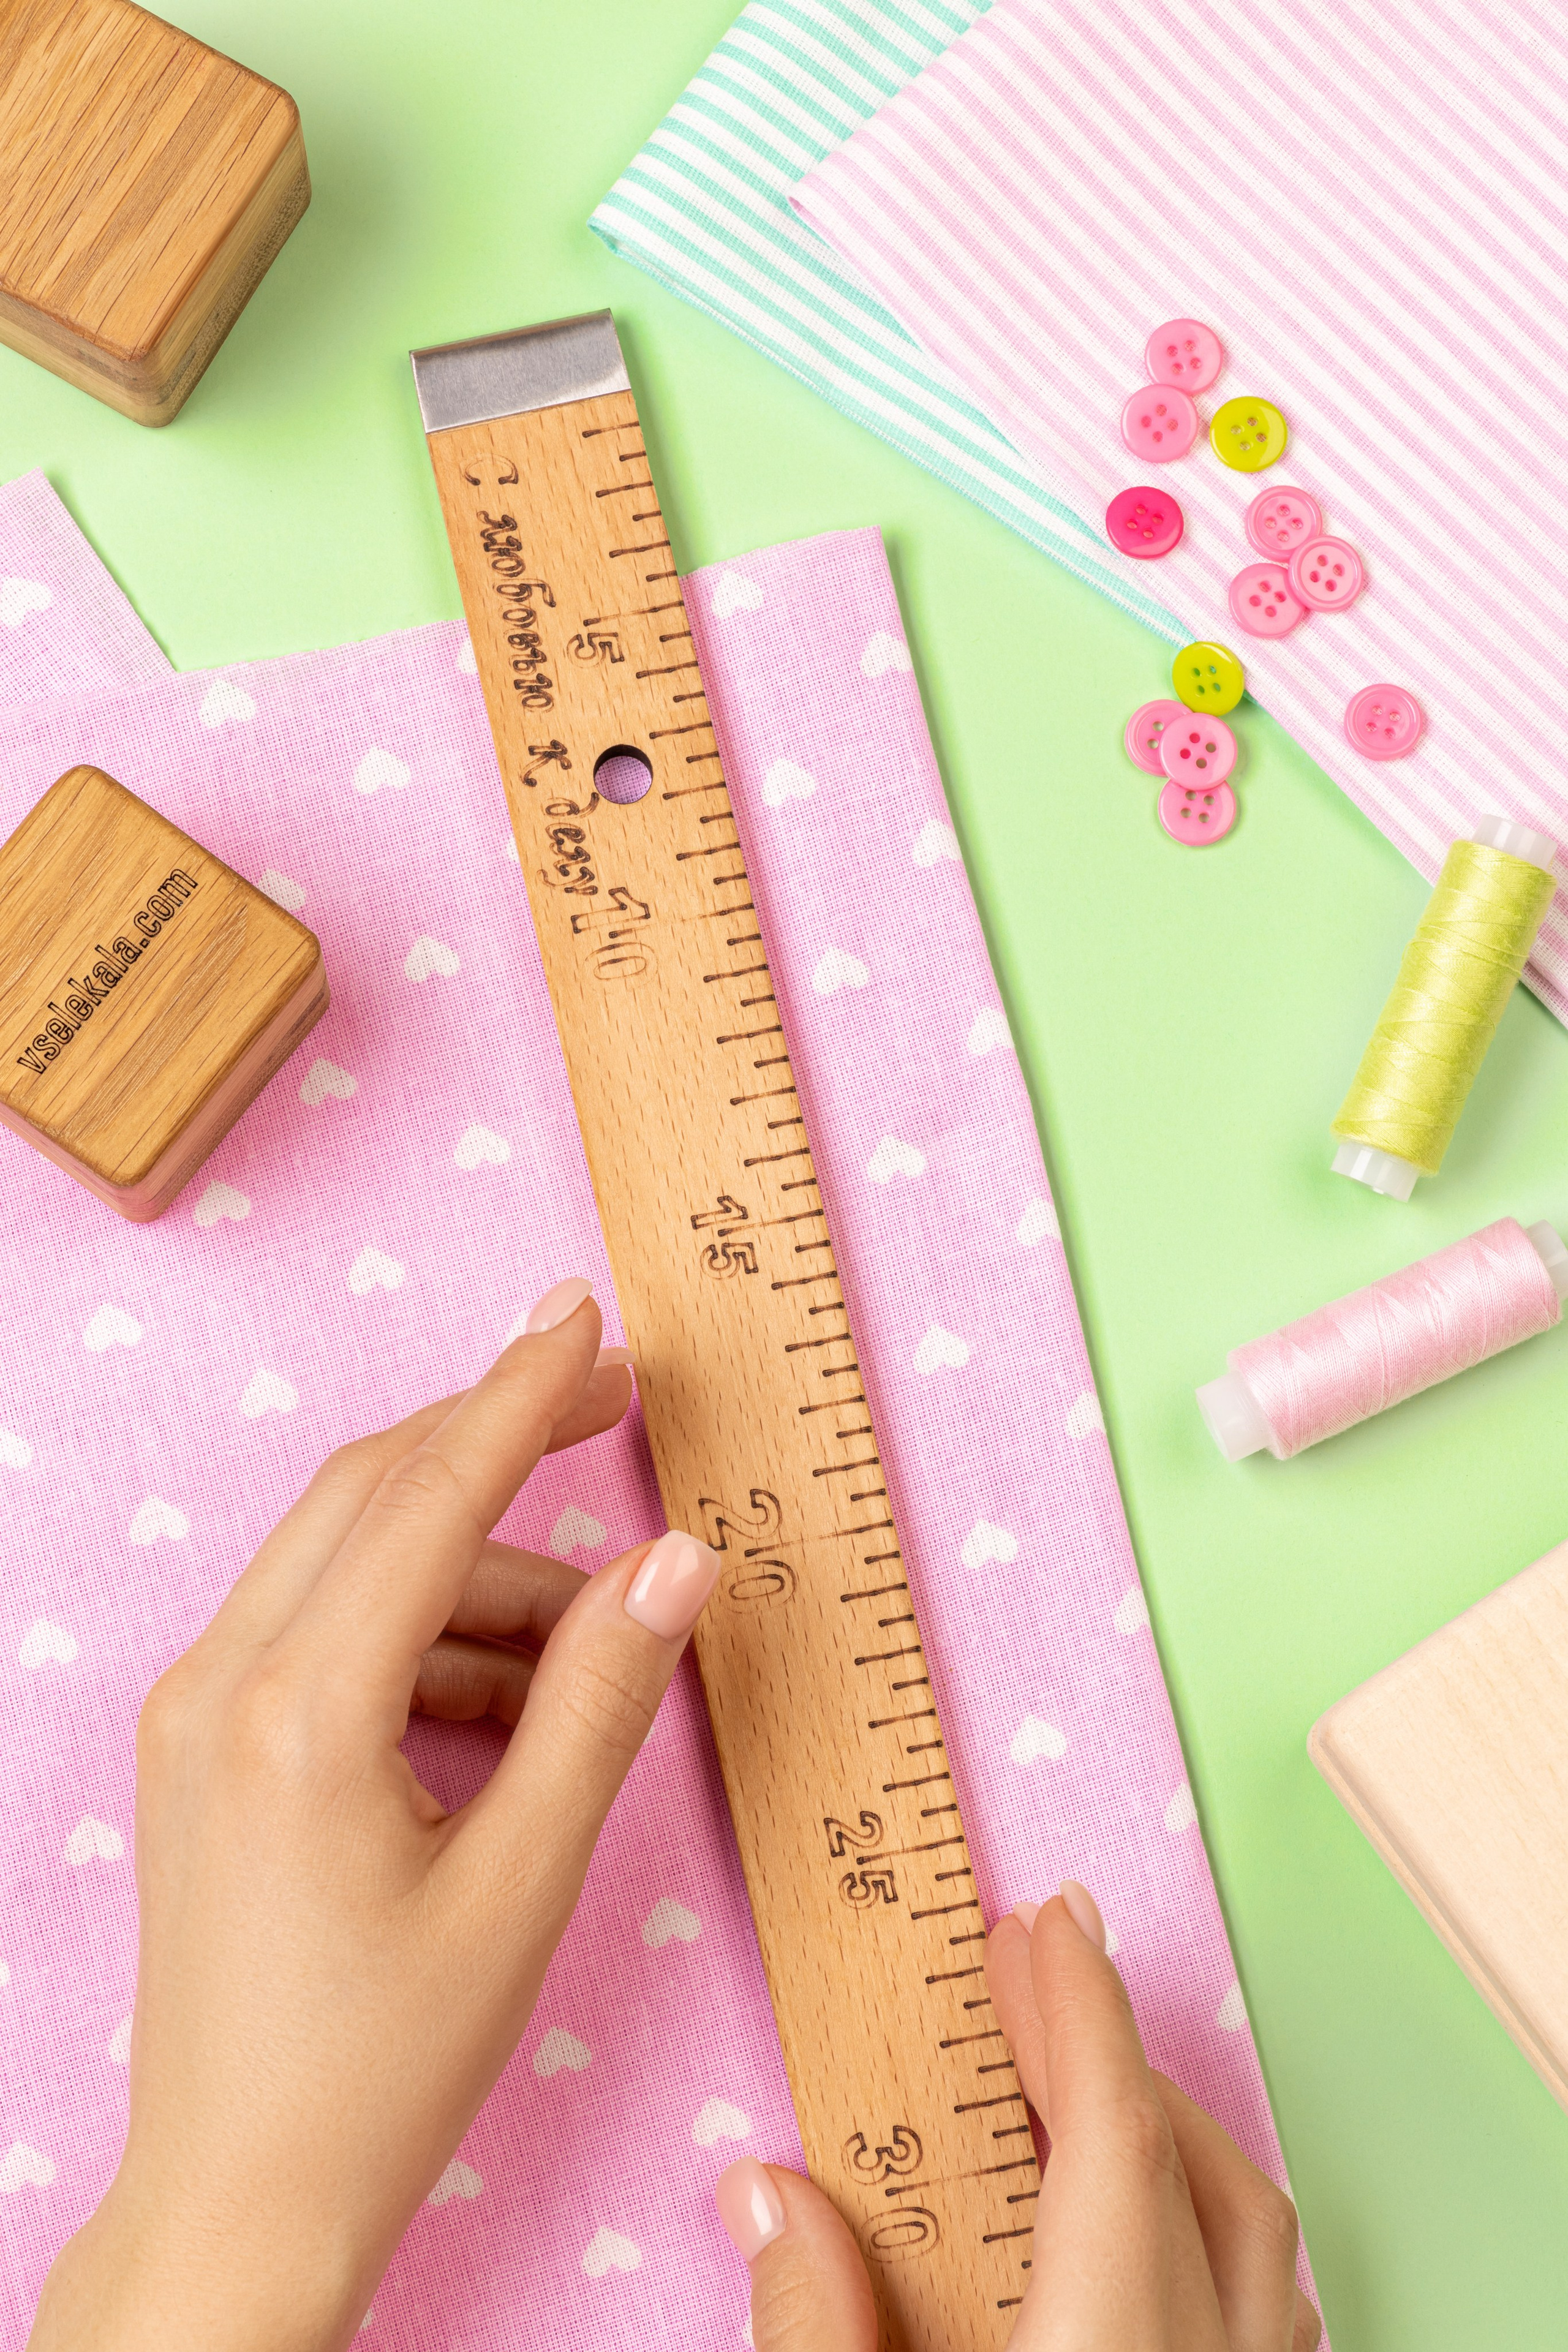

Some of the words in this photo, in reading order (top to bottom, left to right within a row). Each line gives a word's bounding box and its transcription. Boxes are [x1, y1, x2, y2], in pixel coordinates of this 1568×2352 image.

[566, 632, 625, 668] 5
[537, 792, 600, 895] делу
[17, 869, 198, 1074] vselekala.com
[570, 887, 658, 995] 10
[690, 1195, 759, 1281] 15
[698, 1488, 797, 1614] 20
[823, 1811, 899, 1910] 25
[841, 2125, 941, 2264] 30
